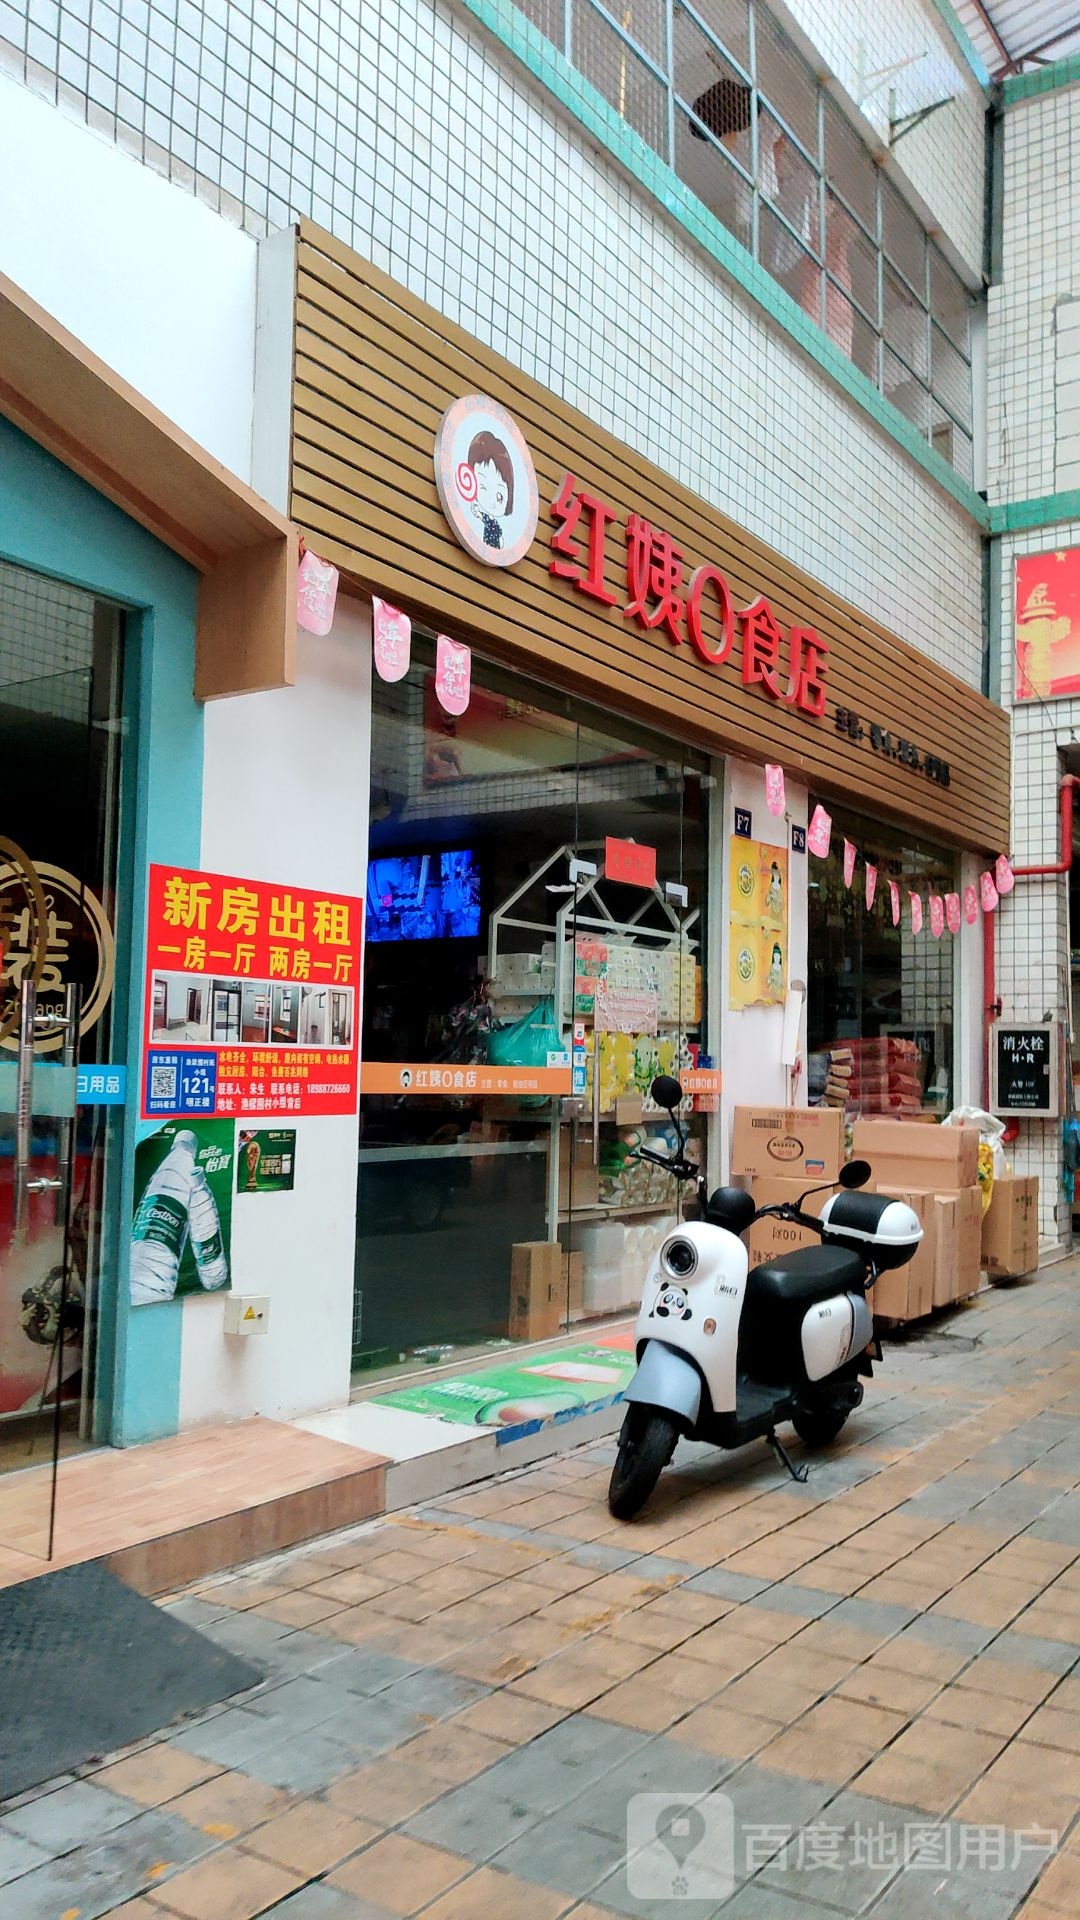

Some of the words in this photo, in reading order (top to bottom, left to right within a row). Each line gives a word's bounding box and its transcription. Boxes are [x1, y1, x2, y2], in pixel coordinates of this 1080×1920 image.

[736, 814, 750, 830] F7
[792, 830, 805, 849] F8
[163, 876, 351, 946] 新房出租
[157, 936, 256, 974] 一房一厅
[269, 946, 353, 982] 两房一厅
[1003, 1036, 1044, 1051] 消火栓
